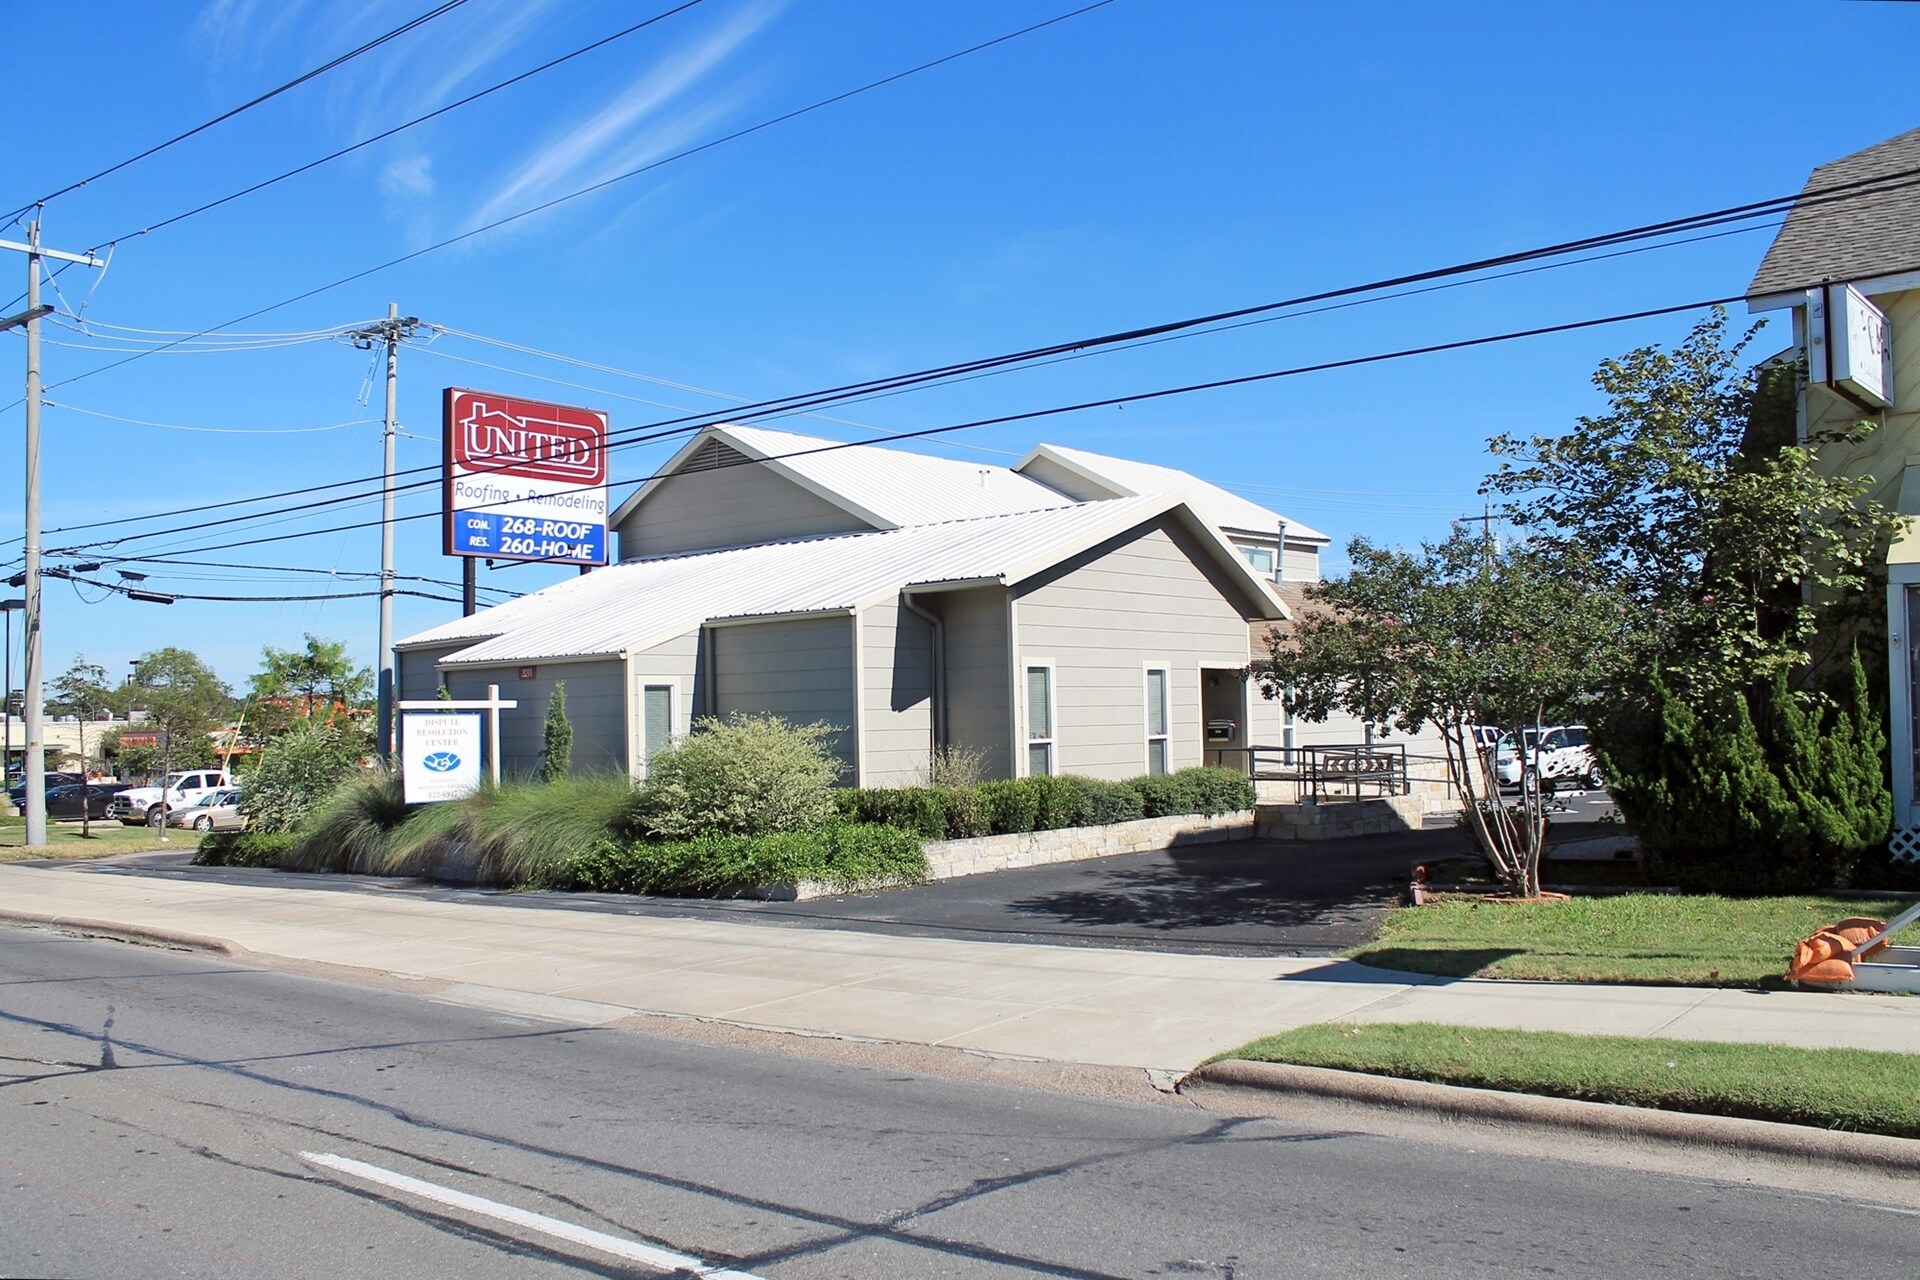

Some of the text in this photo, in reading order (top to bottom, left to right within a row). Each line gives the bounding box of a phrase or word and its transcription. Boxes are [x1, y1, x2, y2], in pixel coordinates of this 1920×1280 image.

[468, 423, 590, 465] UNITED
[455, 481, 605, 514] Roofing Remodeling
[501, 517, 593, 540] 268-ROOF
[469, 535, 595, 559] RES. 260-HOME
[416, 728, 468, 737] RESOLUTION
[425, 718, 460, 726] DISPUTE
[425, 739, 459, 747] CENTER
